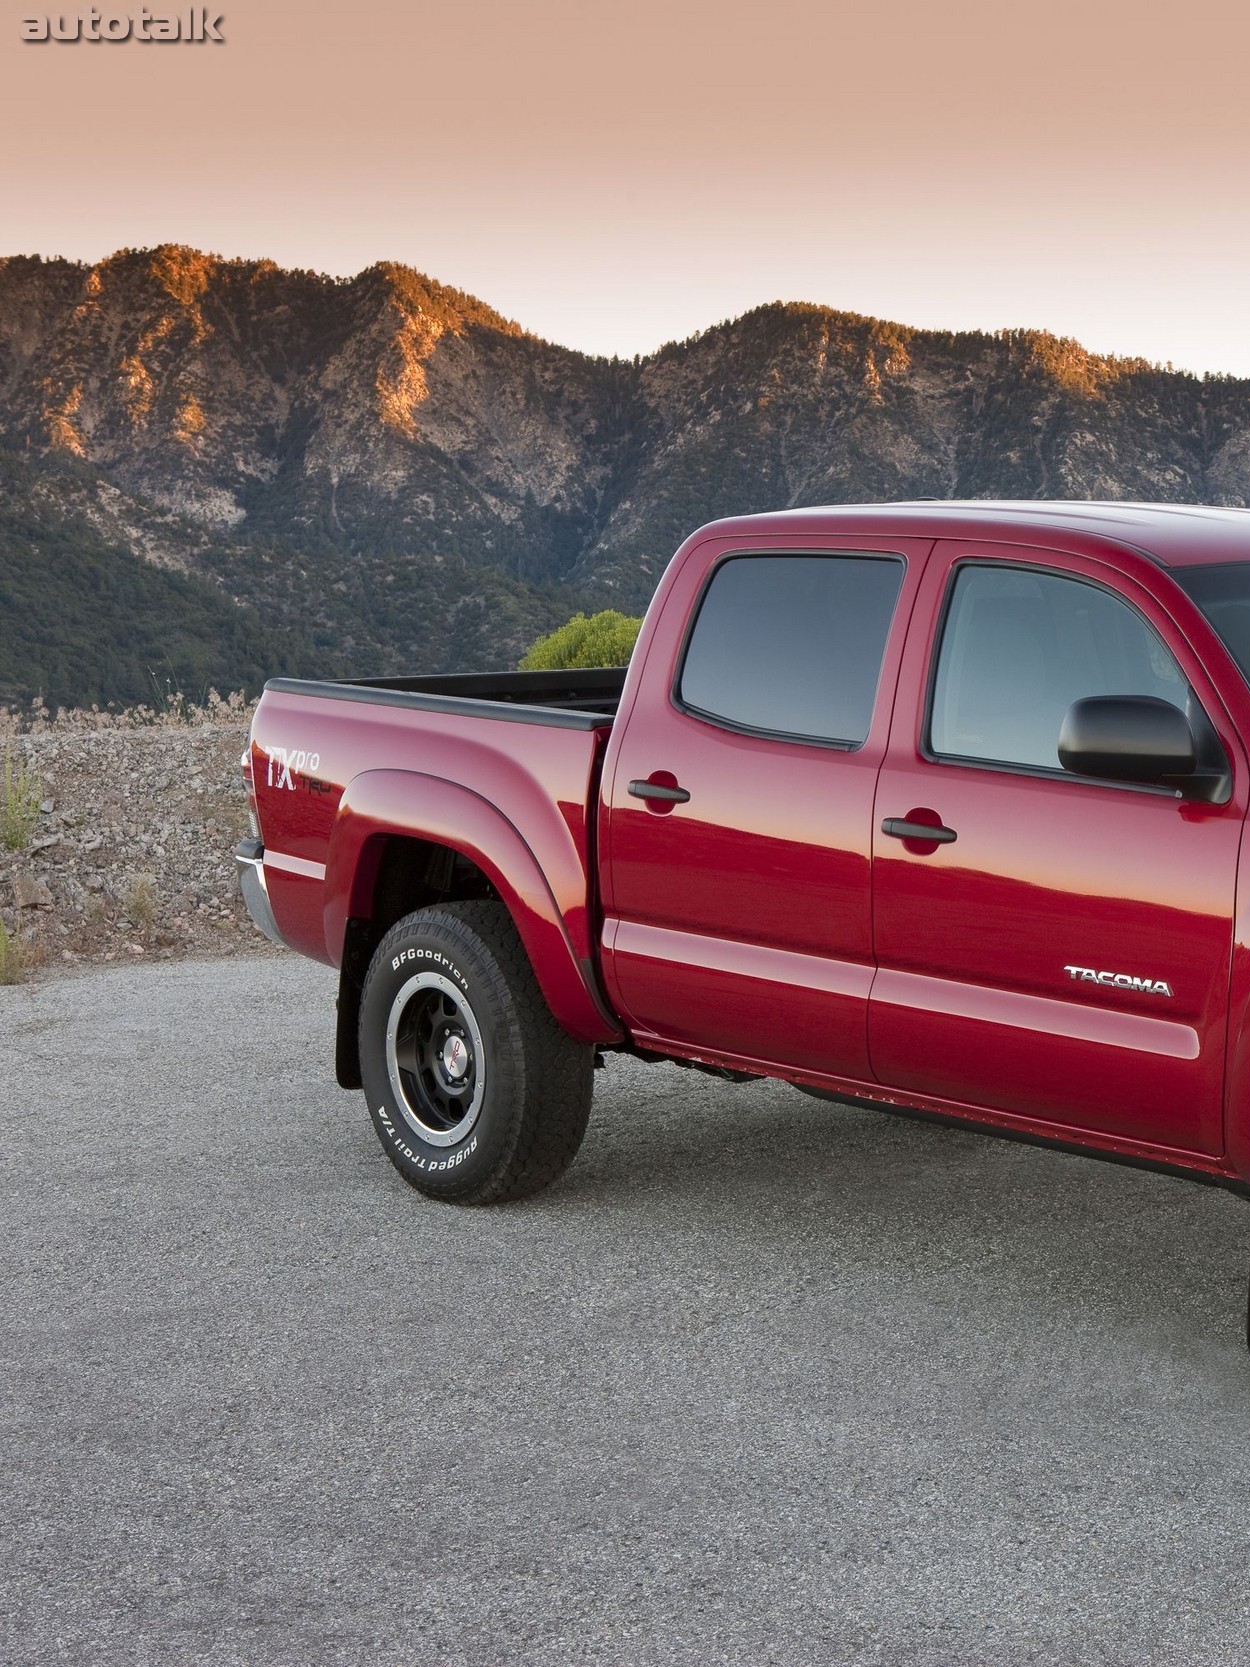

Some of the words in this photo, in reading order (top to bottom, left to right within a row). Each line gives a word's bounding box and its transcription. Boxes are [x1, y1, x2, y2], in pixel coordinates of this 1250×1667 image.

[391, 948, 469, 990] BFGoodrich
[1064, 965, 1174, 997] TACOMA
[378, 1106, 395, 1137] T/A
[395, 1138, 426, 1169] Trail
[428, 1135, 478, 1172] Rugged
